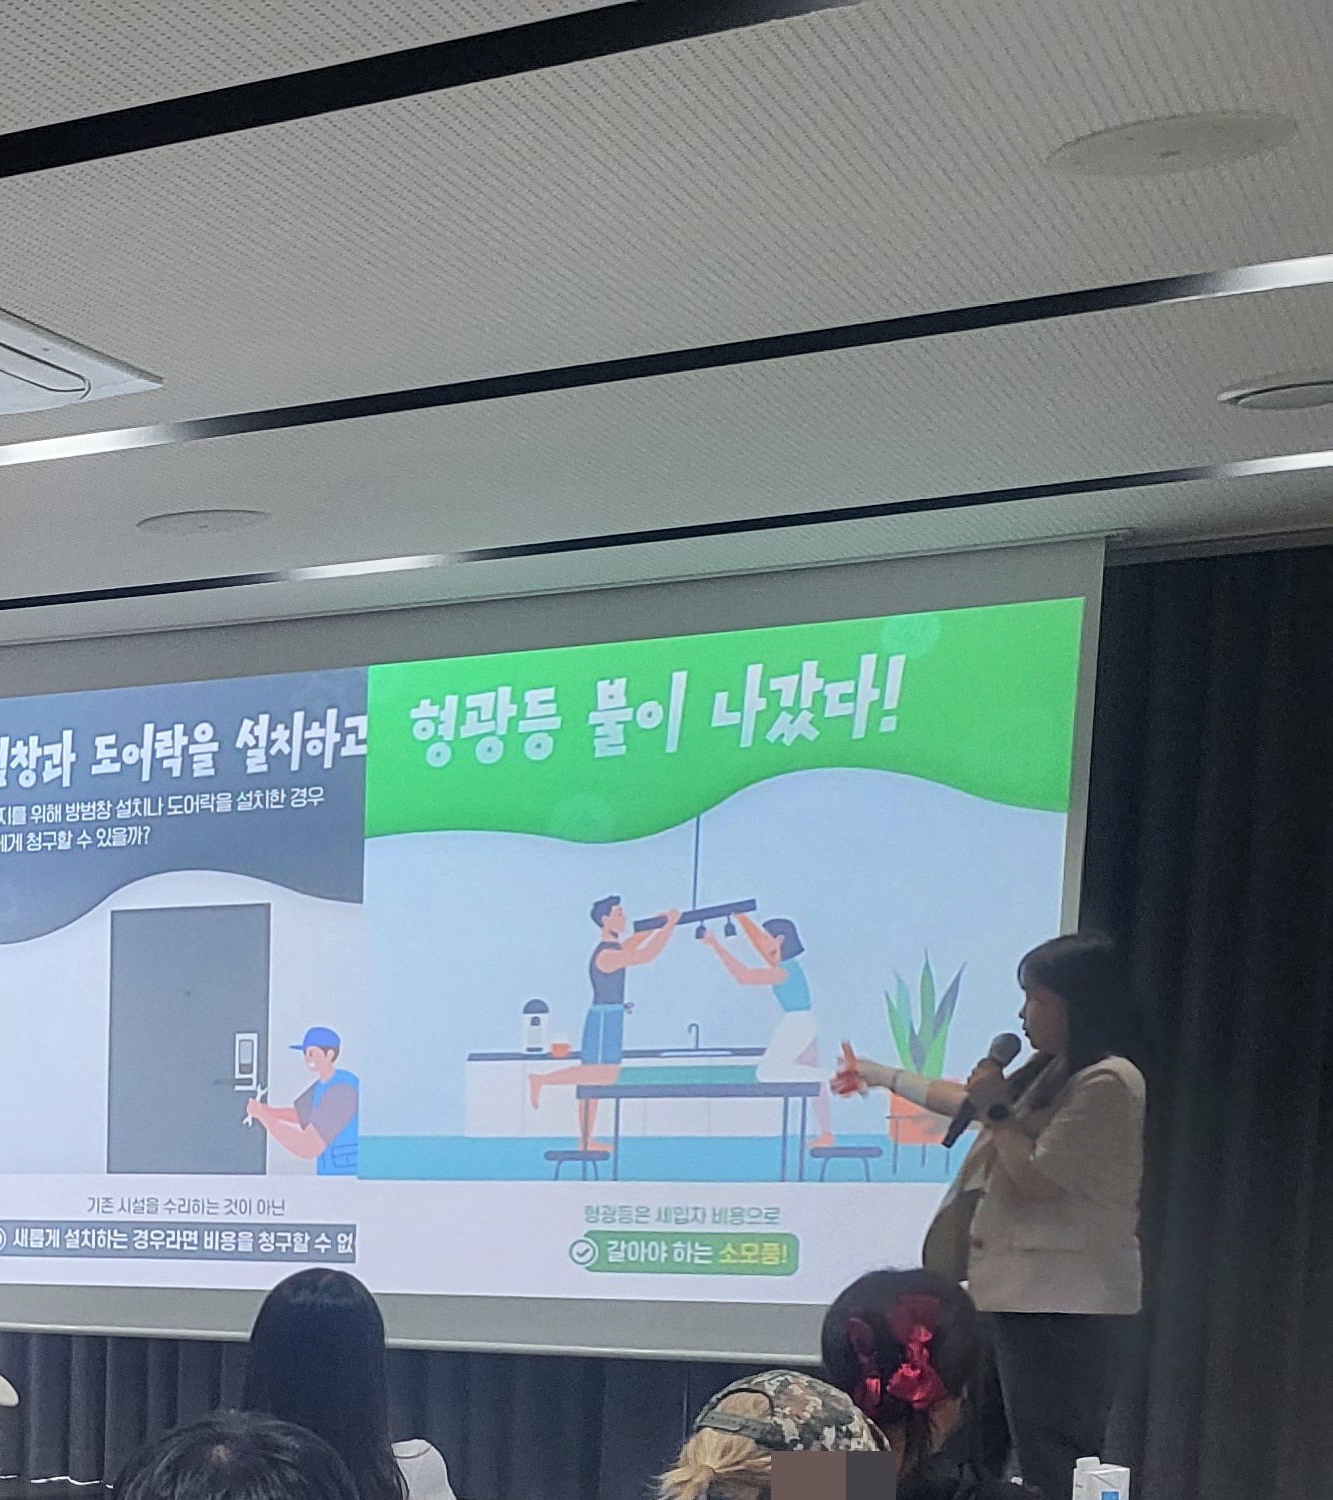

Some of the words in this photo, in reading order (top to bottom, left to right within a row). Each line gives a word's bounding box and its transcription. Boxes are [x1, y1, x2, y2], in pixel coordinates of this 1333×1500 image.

[409, 684, 562, 768] 형광등
[586, 669, 688, 759] 불이
[710, 652, 908, 749] 나갔다!
[90, 722, 220, 782] 도어락을
[235, 707, 369, 774] 설치하고
[30, 803, 62, 824] 위해
[65, 799, 113, 823] 방범창
[116, 796, 164, 819] 설치나
[166, 792, 233, 816] 도어락을
[236, 787, 287, 812] 설치한
[290, 786, 325, 808] 경우
[26, 829, 74, 852] 청구할
[76, 828, 94, 851] 수
[96, 825, 151, 849] 있을까?
[87, 1196, 115, 1214] 기존
[117, 1196, 160, 1215] 시설을
[163, 1197, 220, 1216] 수리하는
[223, 1197, 252, 1216] 것이
[256, 1198, 286, 1217] 아닌
[584, 1204, 651, 1225] 형광등은
[655, 1206, 707, 1225] 세입자
[711, 1207, 781, 1226] 비용으로
[12, 1227, 61, 1250] 새롭게
[64, 1227, 129, 1250] 설치하는
[132, 1229, 199, 1252] 경우라면
[203, 1230, 255, 1253] 비용을
[258, 1231, 311, 1254] 청구할
[314, 1232, 332, 1255] 수
[336, 1233, 356, 1255] 없
[607, 1240, 669, 1264] 갈아야
[672, 1241, 713, 1264] 하는
[718, 1242, 788, 1266] 소모품!
